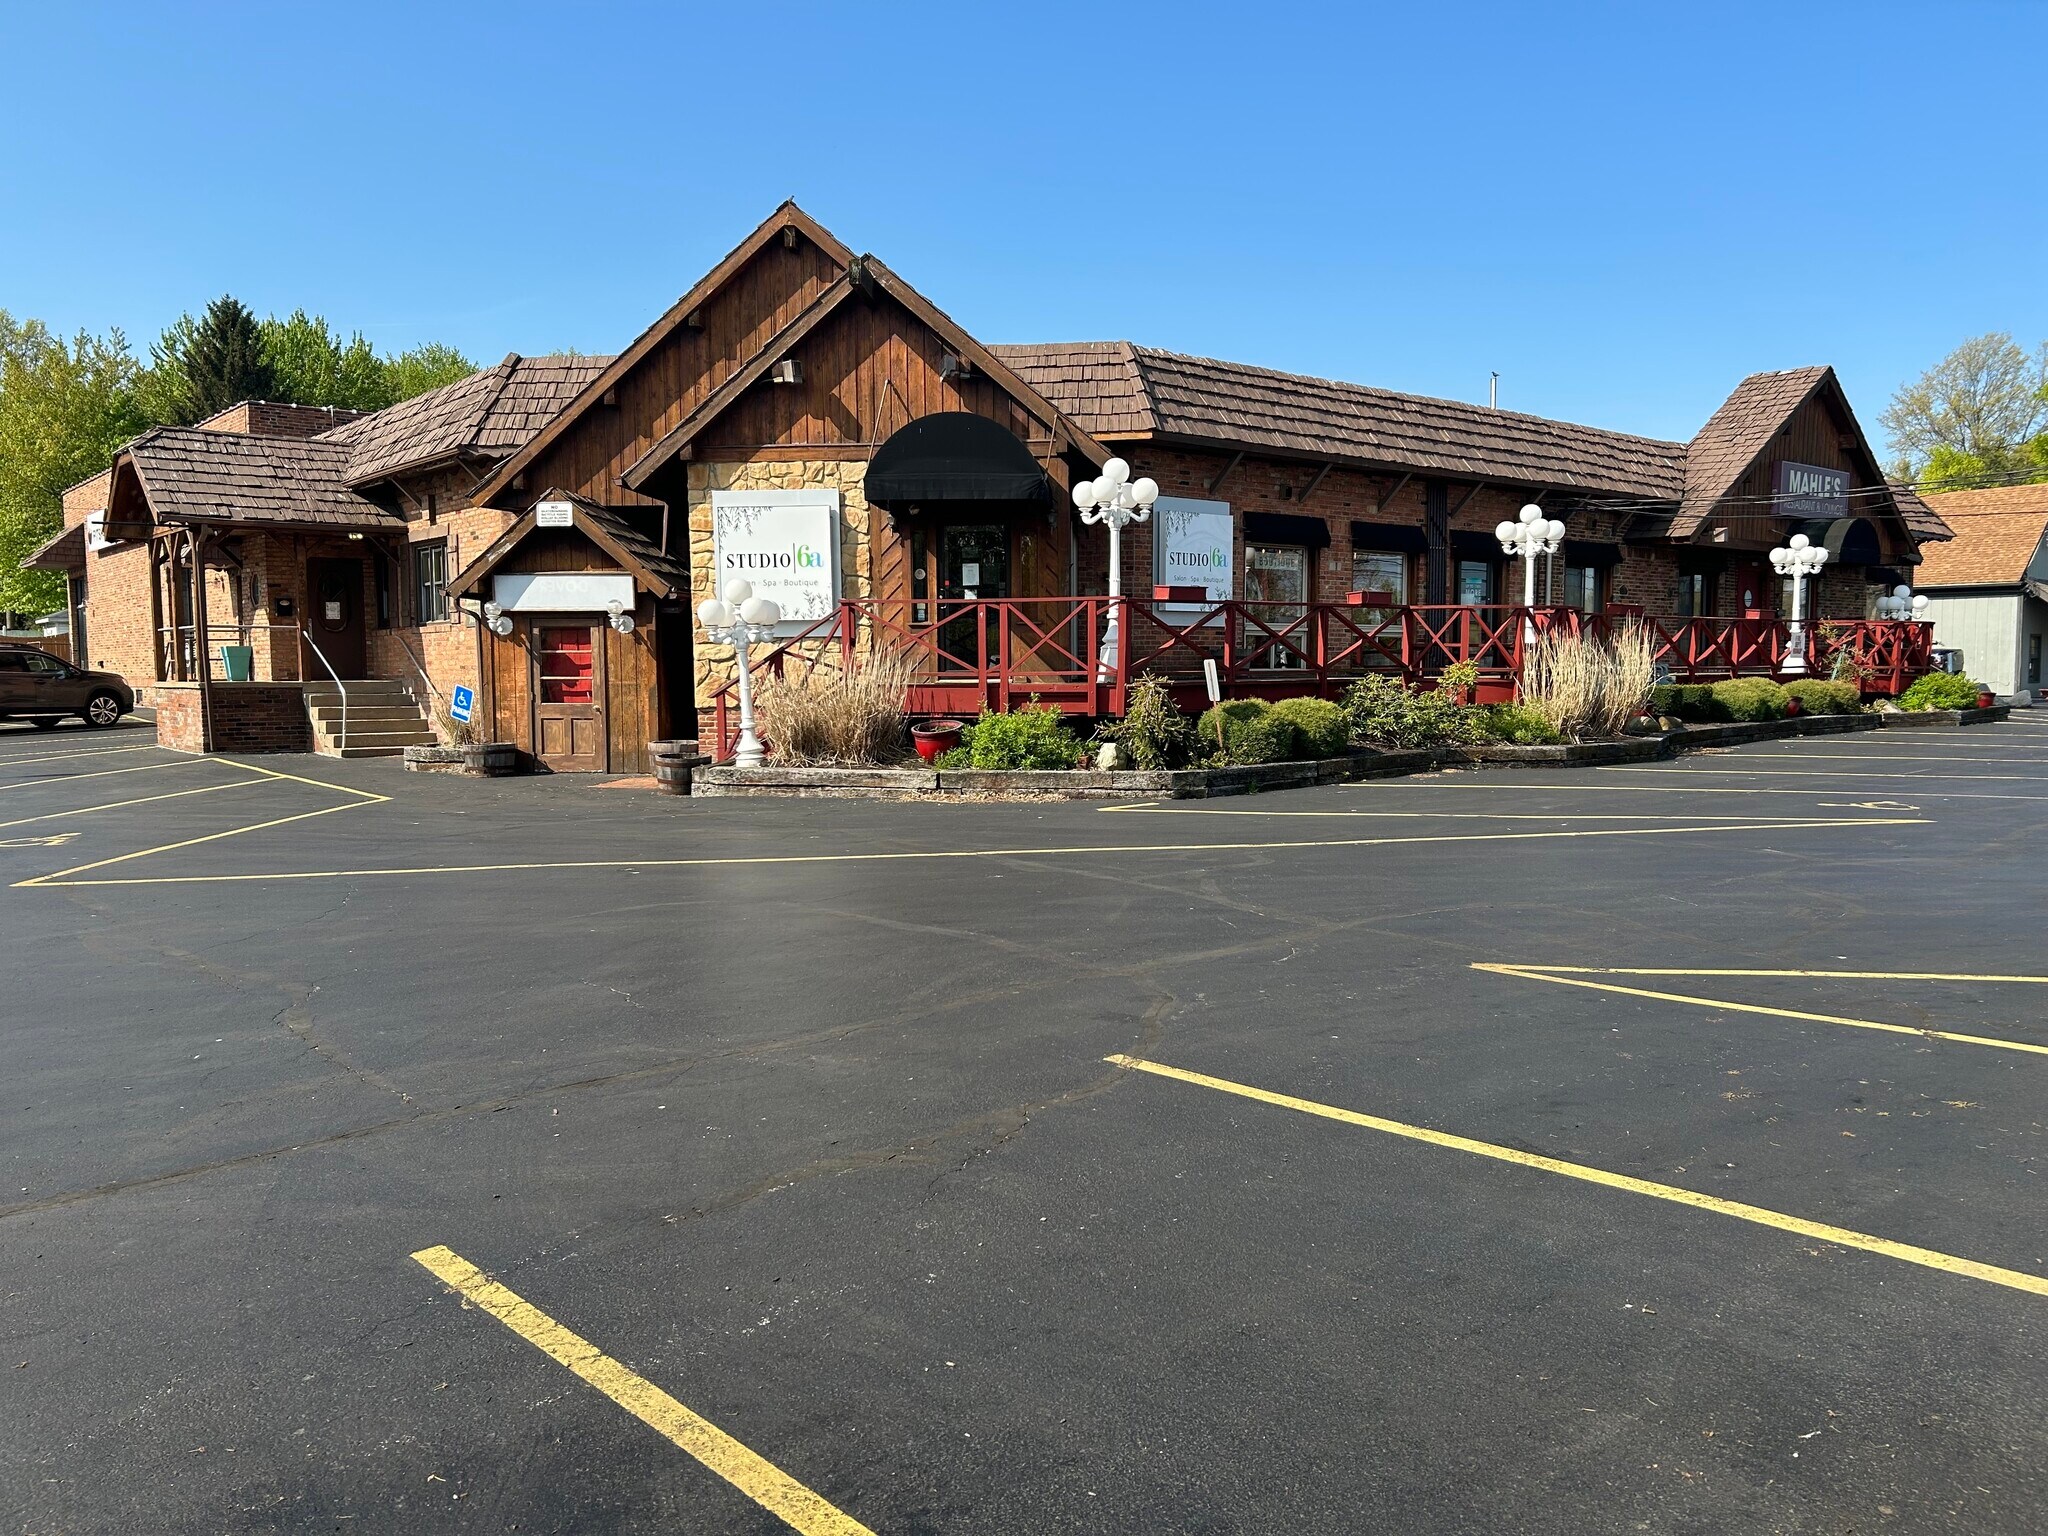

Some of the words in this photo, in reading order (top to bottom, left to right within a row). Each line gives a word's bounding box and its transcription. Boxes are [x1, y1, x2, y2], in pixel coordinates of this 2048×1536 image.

[1789, 470, 1841, 499] MAHLE'S
[726, 553, 791, 568] STUDIO
[797, 544, 824, 568] 6a
[1169, 552, 1209, 566] STUDIO
[1212, 547, 1228, 568] 6a
[763, 579, 777, 587] Spa
[784, 579, 818, 587] Boutique
[1203, 576, 1224, 584] Boutique
